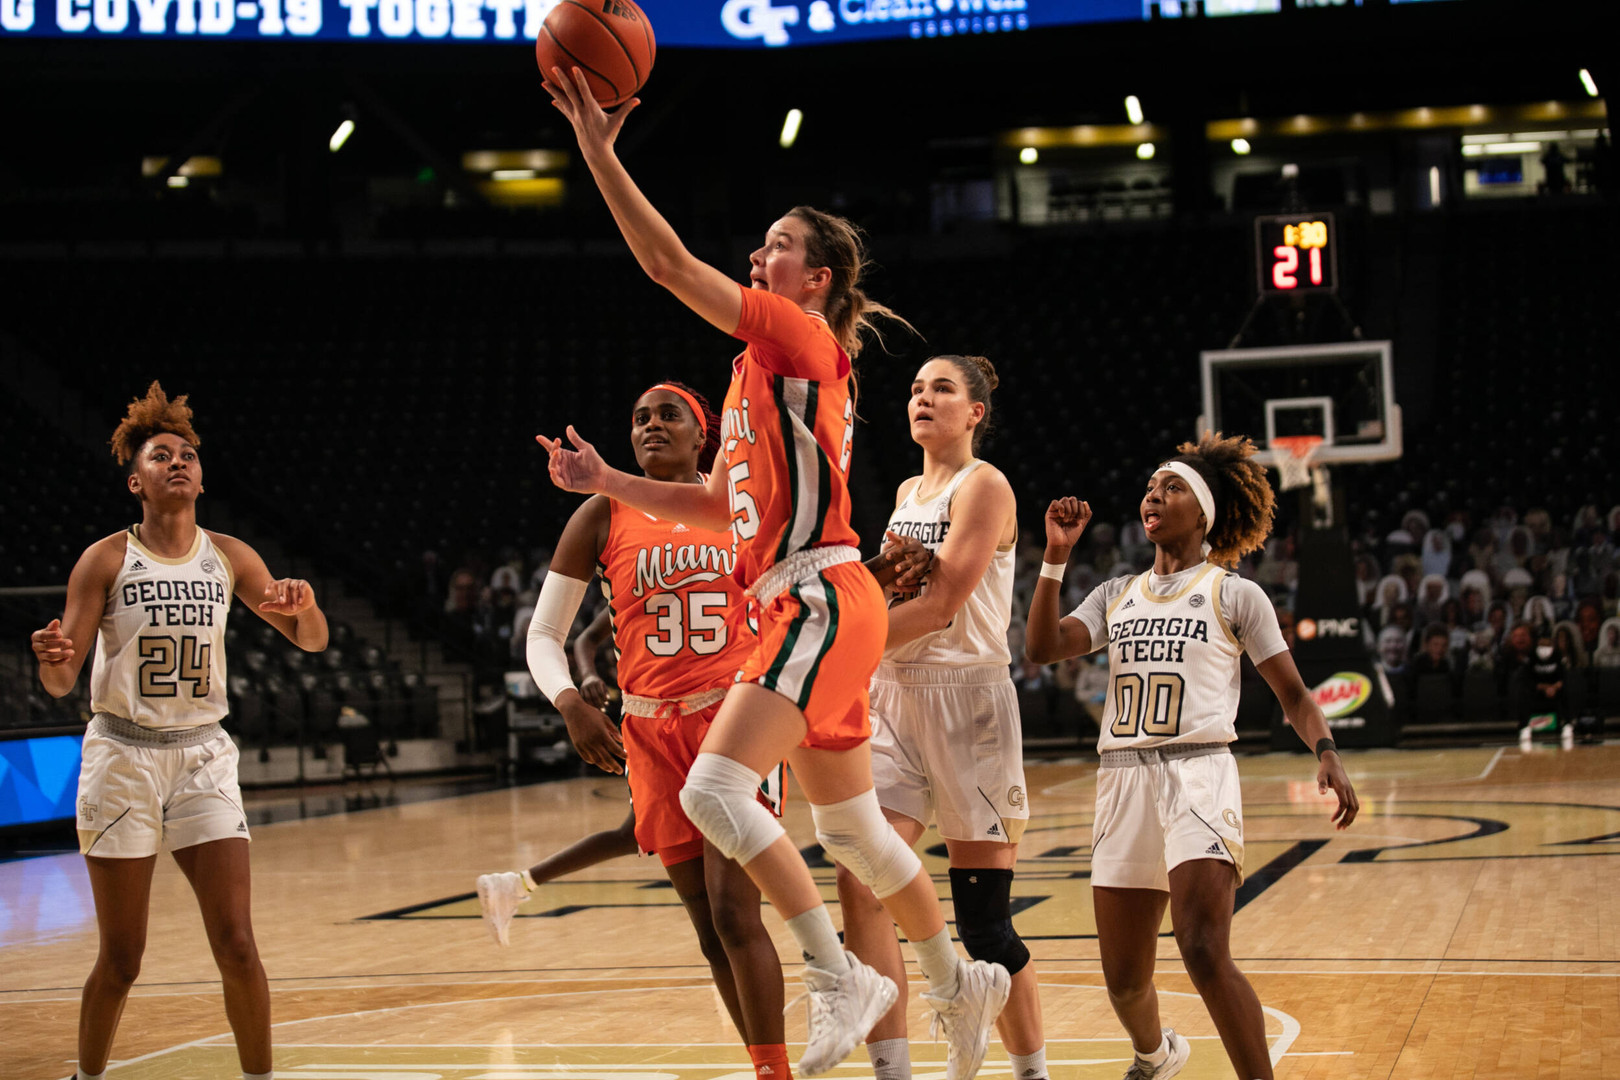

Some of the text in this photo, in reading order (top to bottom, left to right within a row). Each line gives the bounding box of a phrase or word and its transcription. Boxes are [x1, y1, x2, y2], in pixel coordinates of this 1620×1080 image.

[56, 0, 322, 36] COVID-19
[1272, 246, 1322, 289] 21
[727, 460, 761, 541] 5
[632, 542, 737, 597] Miami
[122, 580, 225, 606] GEORGIA
[145, 604, 214, 627] TECH
[644, 591, 728, 657] 35
[1109, 617, 1208, 644] GEORGIA
[1317, 617, 1360, 638] PNC
[138, 635, 211, 698] 24
[1118, 640, 1186, 663] TECH
[1110, 672, 1185, 738] 00
